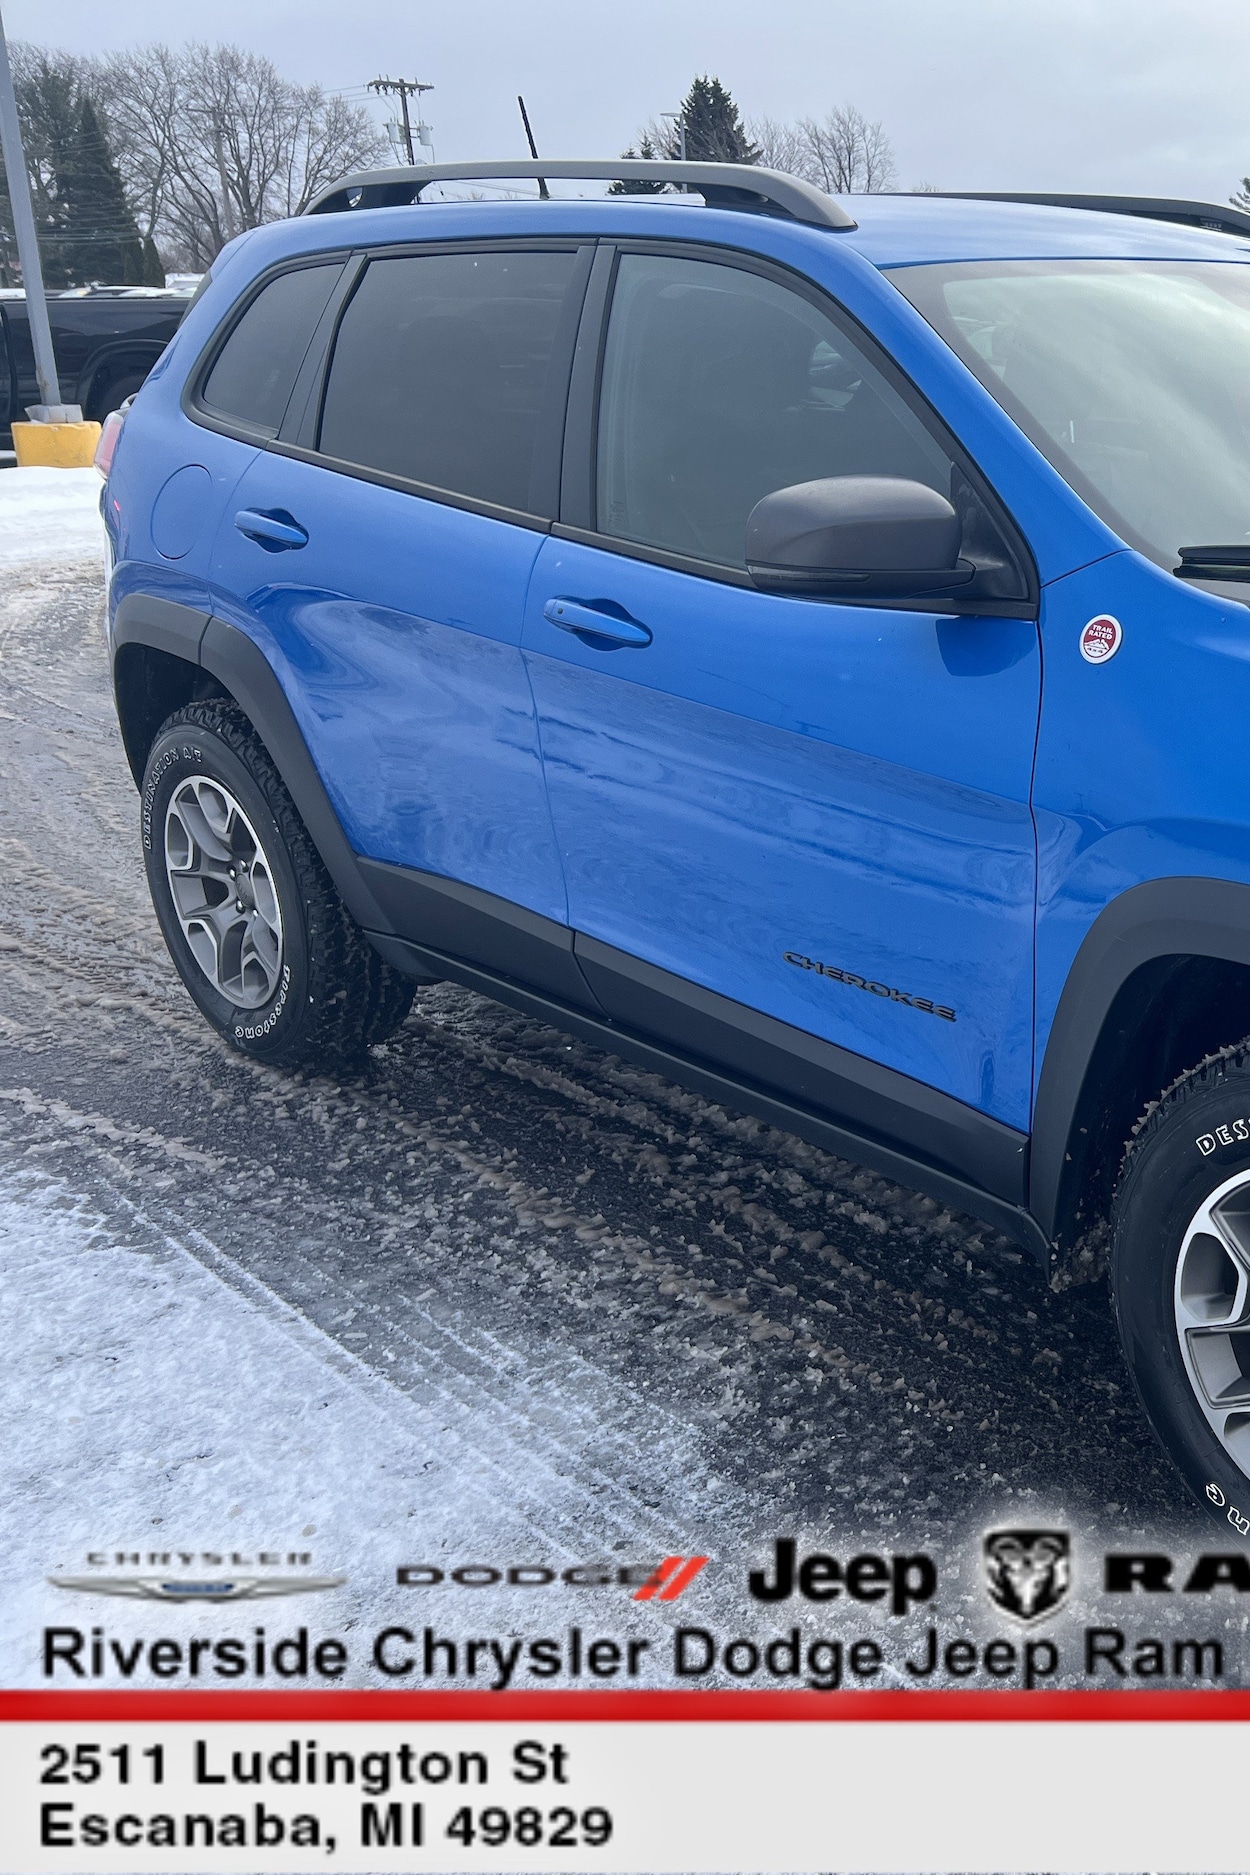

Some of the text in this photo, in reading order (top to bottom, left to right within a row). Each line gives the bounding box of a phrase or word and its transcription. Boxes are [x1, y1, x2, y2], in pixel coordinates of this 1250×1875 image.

[1088, 630, 1113, 640] RATED
[1093, 624, 1113, 634] TRAIL
[143, 747, 180, 850] DESTINATION
[234, 964, 291, 1039] Firestone
[782, 951, 957, 1023] CHEROKEE
